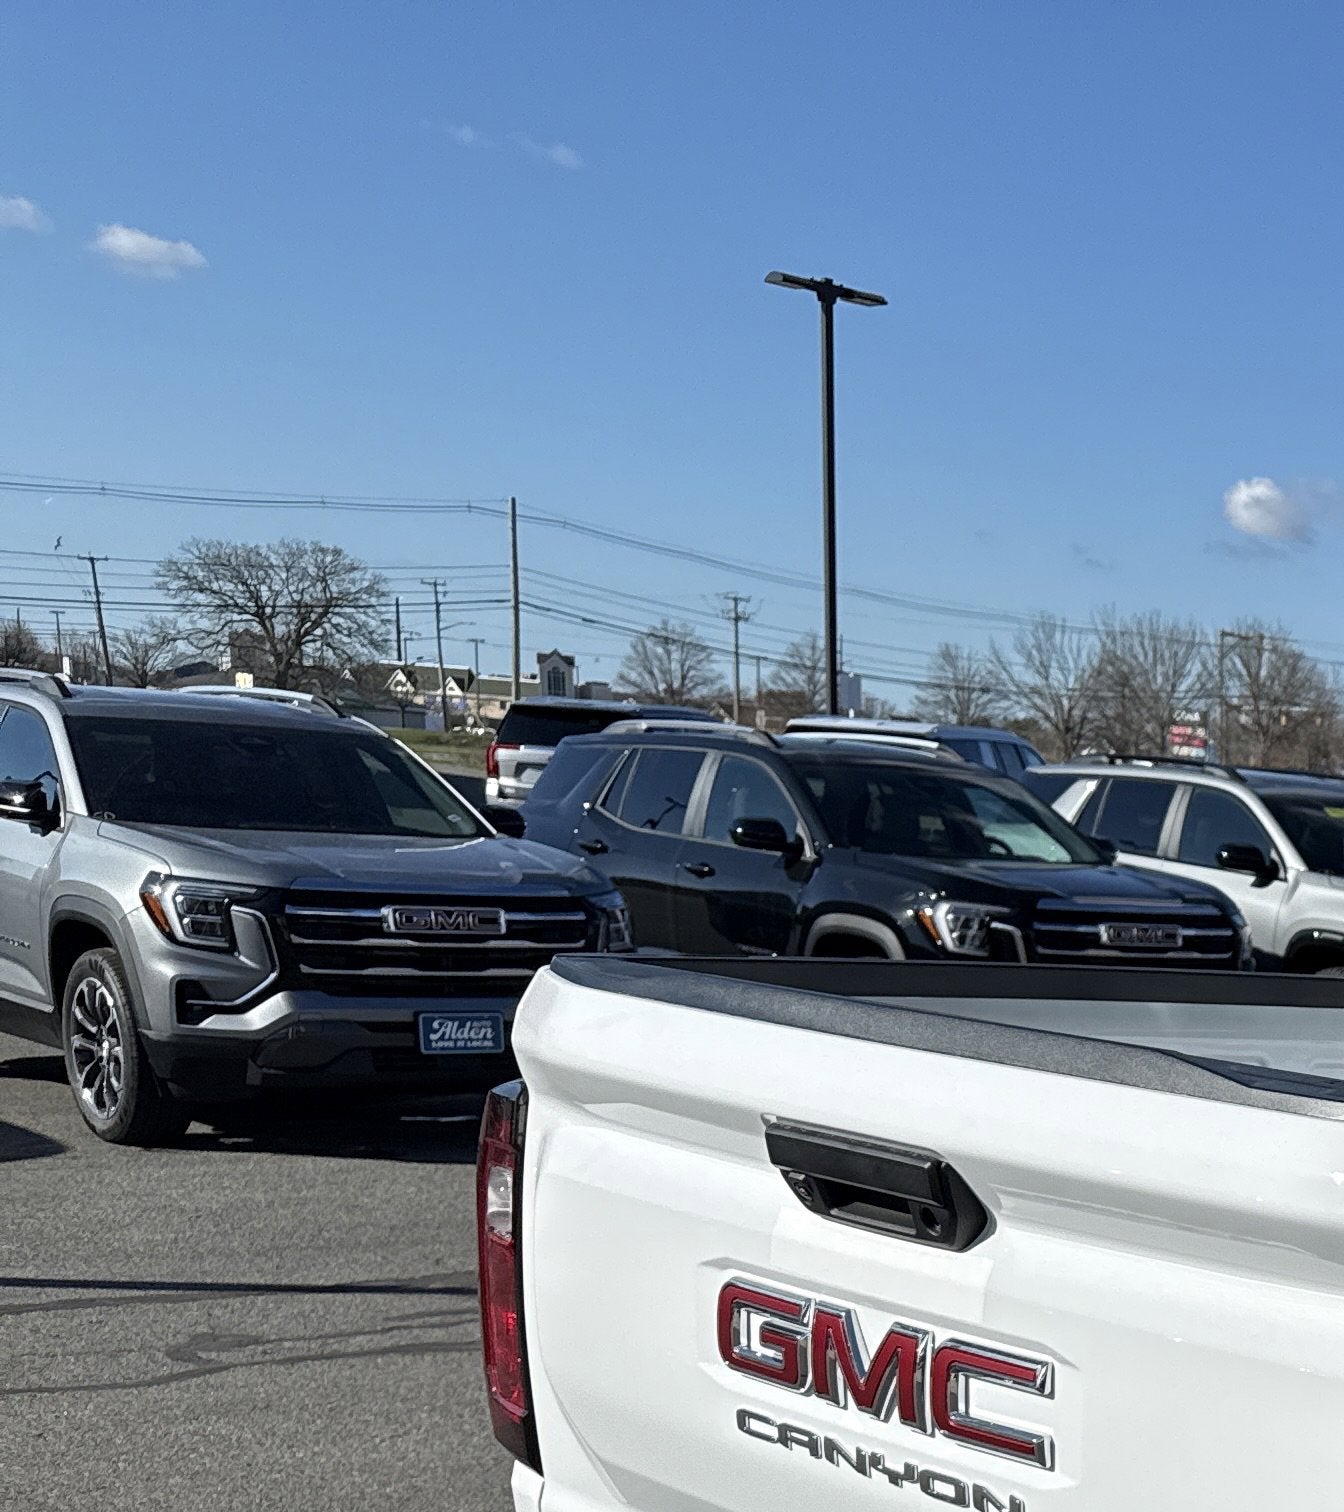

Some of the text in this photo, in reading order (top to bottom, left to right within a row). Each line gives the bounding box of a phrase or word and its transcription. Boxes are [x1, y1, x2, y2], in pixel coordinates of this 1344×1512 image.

[395, 910, 500, 931] GMC
[429, 1018, 496, 1041] Alden
[717, 1277, 1056, 1472] GMC
